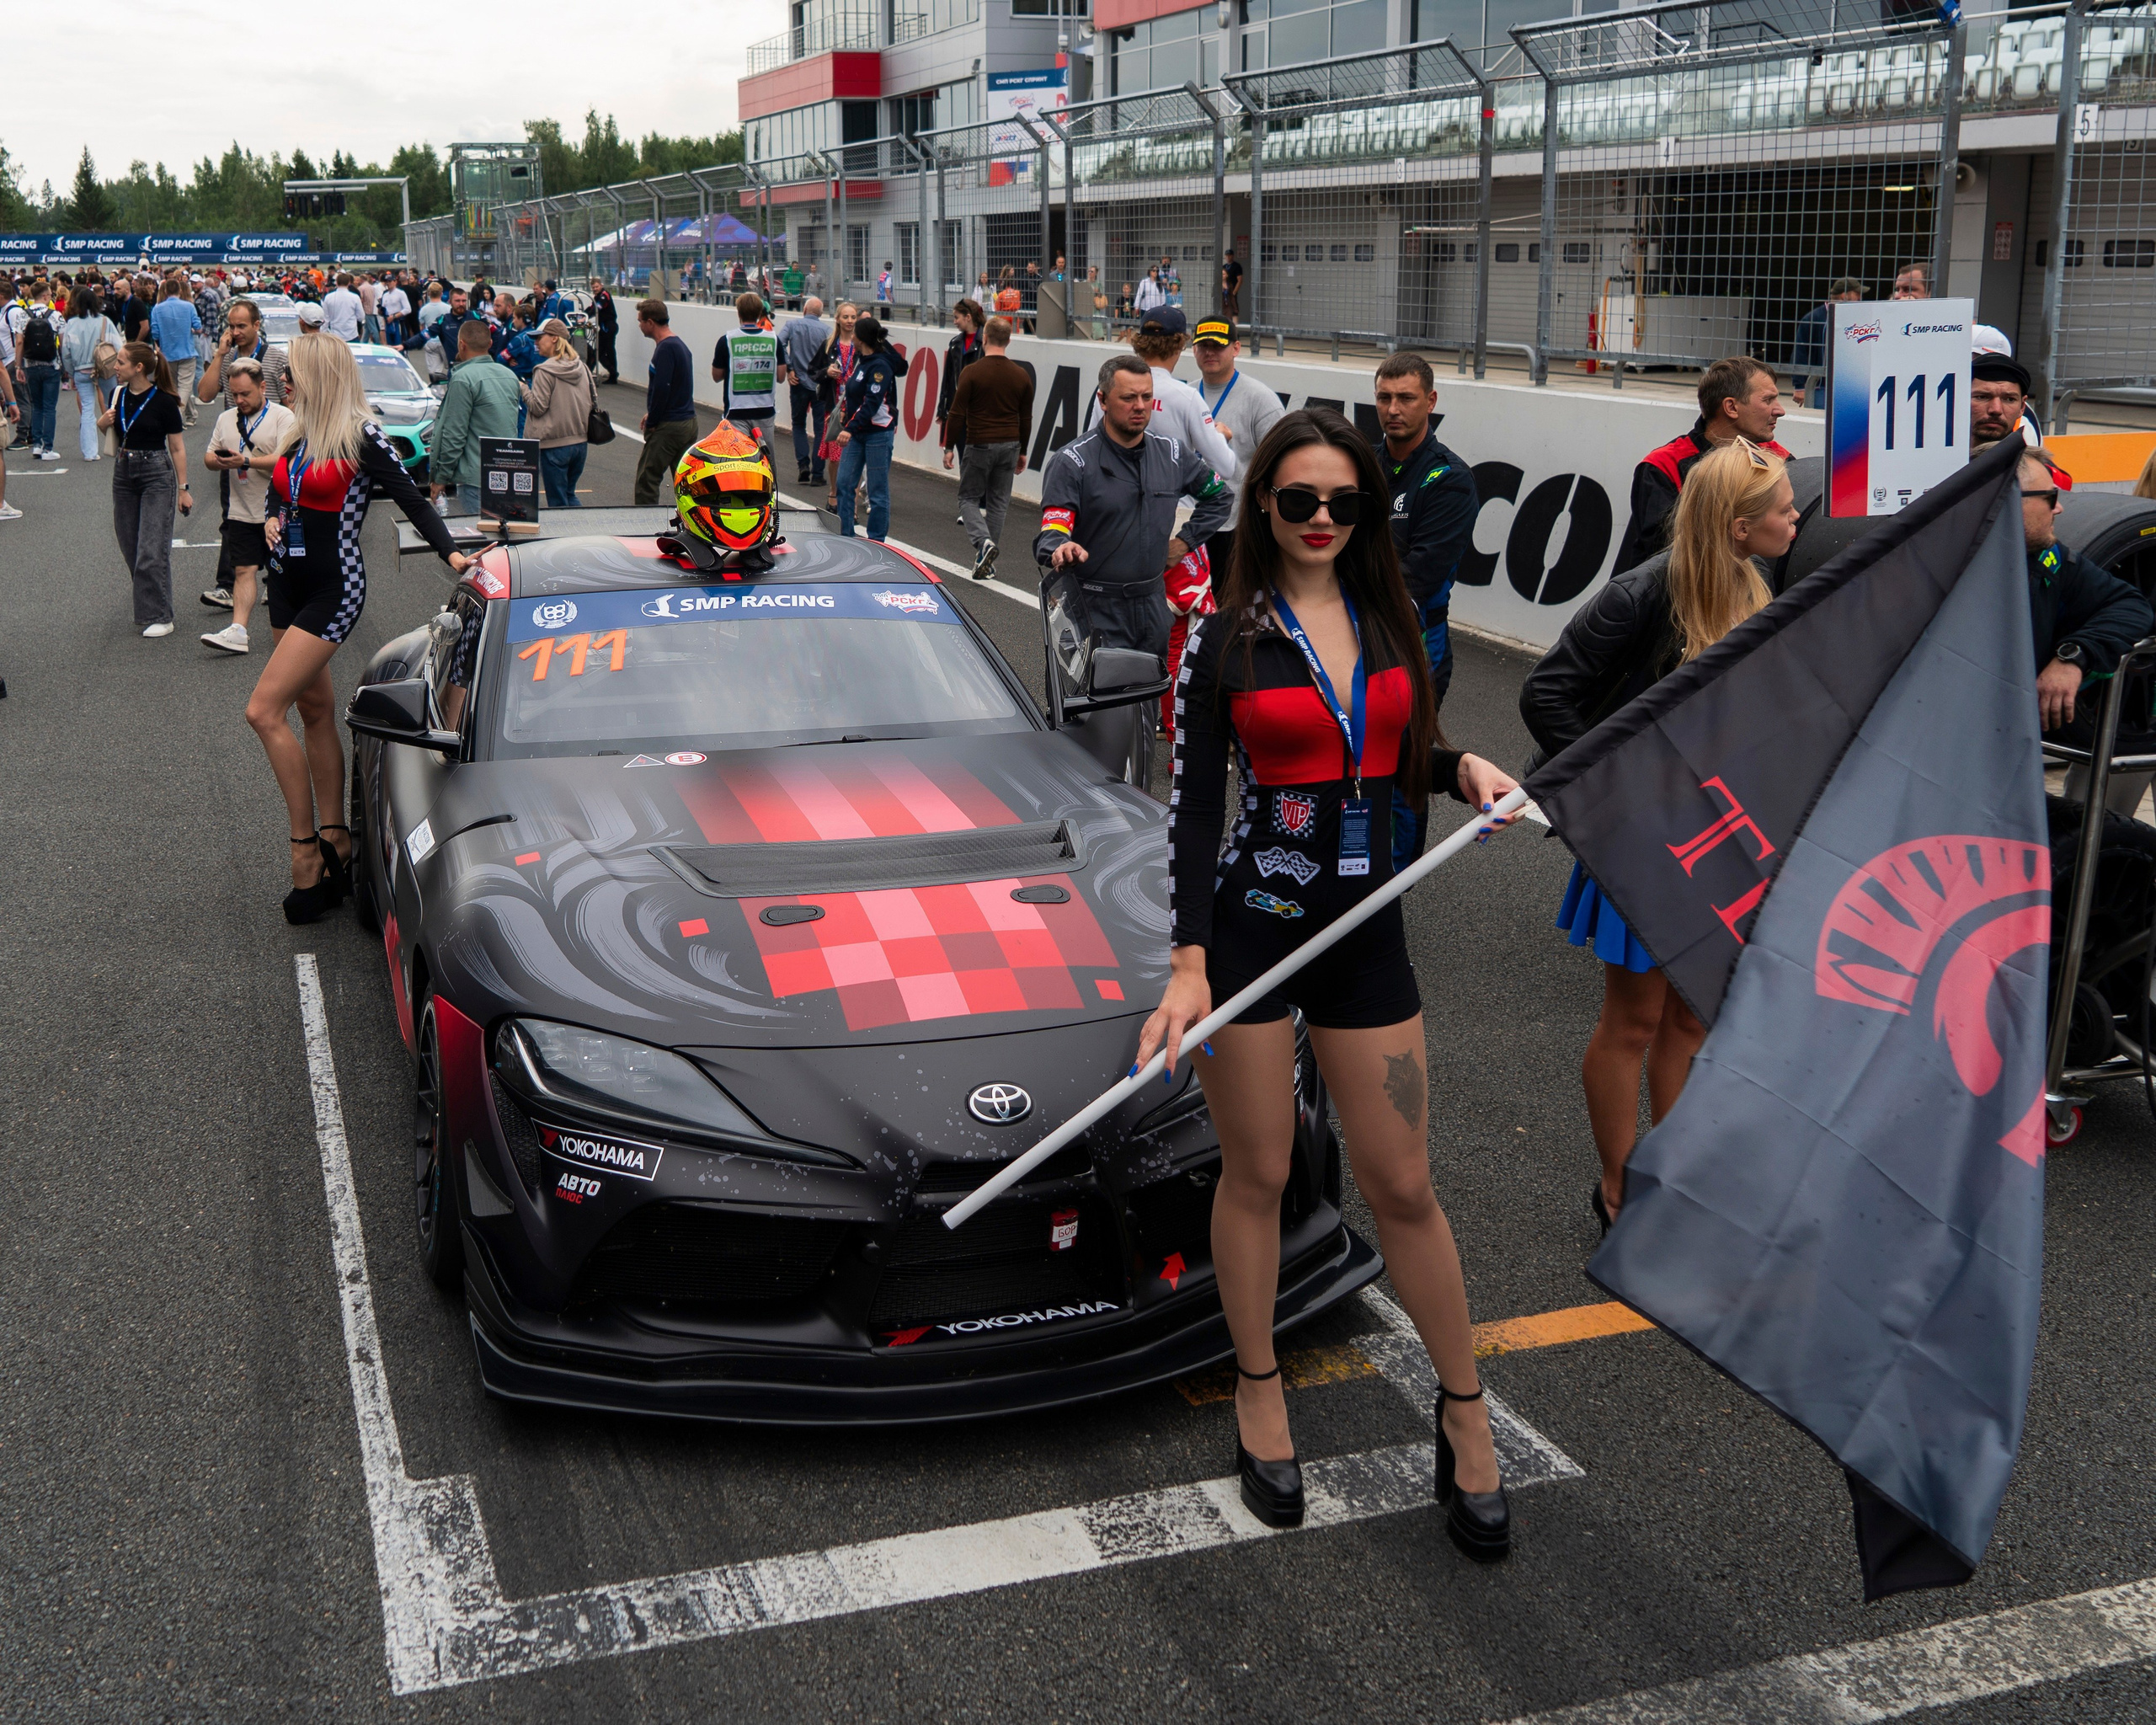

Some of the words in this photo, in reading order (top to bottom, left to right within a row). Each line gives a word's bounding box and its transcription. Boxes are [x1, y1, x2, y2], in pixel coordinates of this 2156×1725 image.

[2079, 109, 2090, 136] 5
[1, 240, 37, 249] RACING
[65, 239, 86, 249] SMP
[87, 239, 125, 248] RACING
[152, 239, 173, 248] SMP
[174, 238, 211, 248] RACING
[240, 239, 263, 248] SMP
[264, 238, 302, 248] RACING
[1198, 325, 1226, 334] PIRELLI
[1853, 328, 1876, 336] РСКГ
[1913, 325, 1930, 334] SMP
[1932, 324, 1962, 333] RACING
[734, 343, 773, 353] ПРЕССА
[755, 360, 771, 369] 174
[1877, 372, 1956, 450] 111
[691, 512, 712, 537] ACADEMY
[1455, 461, 1632, 606] CO
[680, 595, 736, 611] SMP
[741, 595, 835, 609] RACING
[890, 596, 926, 605] РСКГ
[518, 628, 627, 682] 111
[1296, 636, 1309, 650] SMP
[1304, 649, 1321, 673] RACING
[1342, 719, 1352, 735] SMP
[1283, 800, 1309, 825] VIP
[558, 1134, 644, 1170] YOKOHAMA
[558, 1172, 601, 1197] АВТО
[555, 1188, 584, 1204] ПЛЮС
[936, 1300, 1120, 1336] YOKOHAMA
